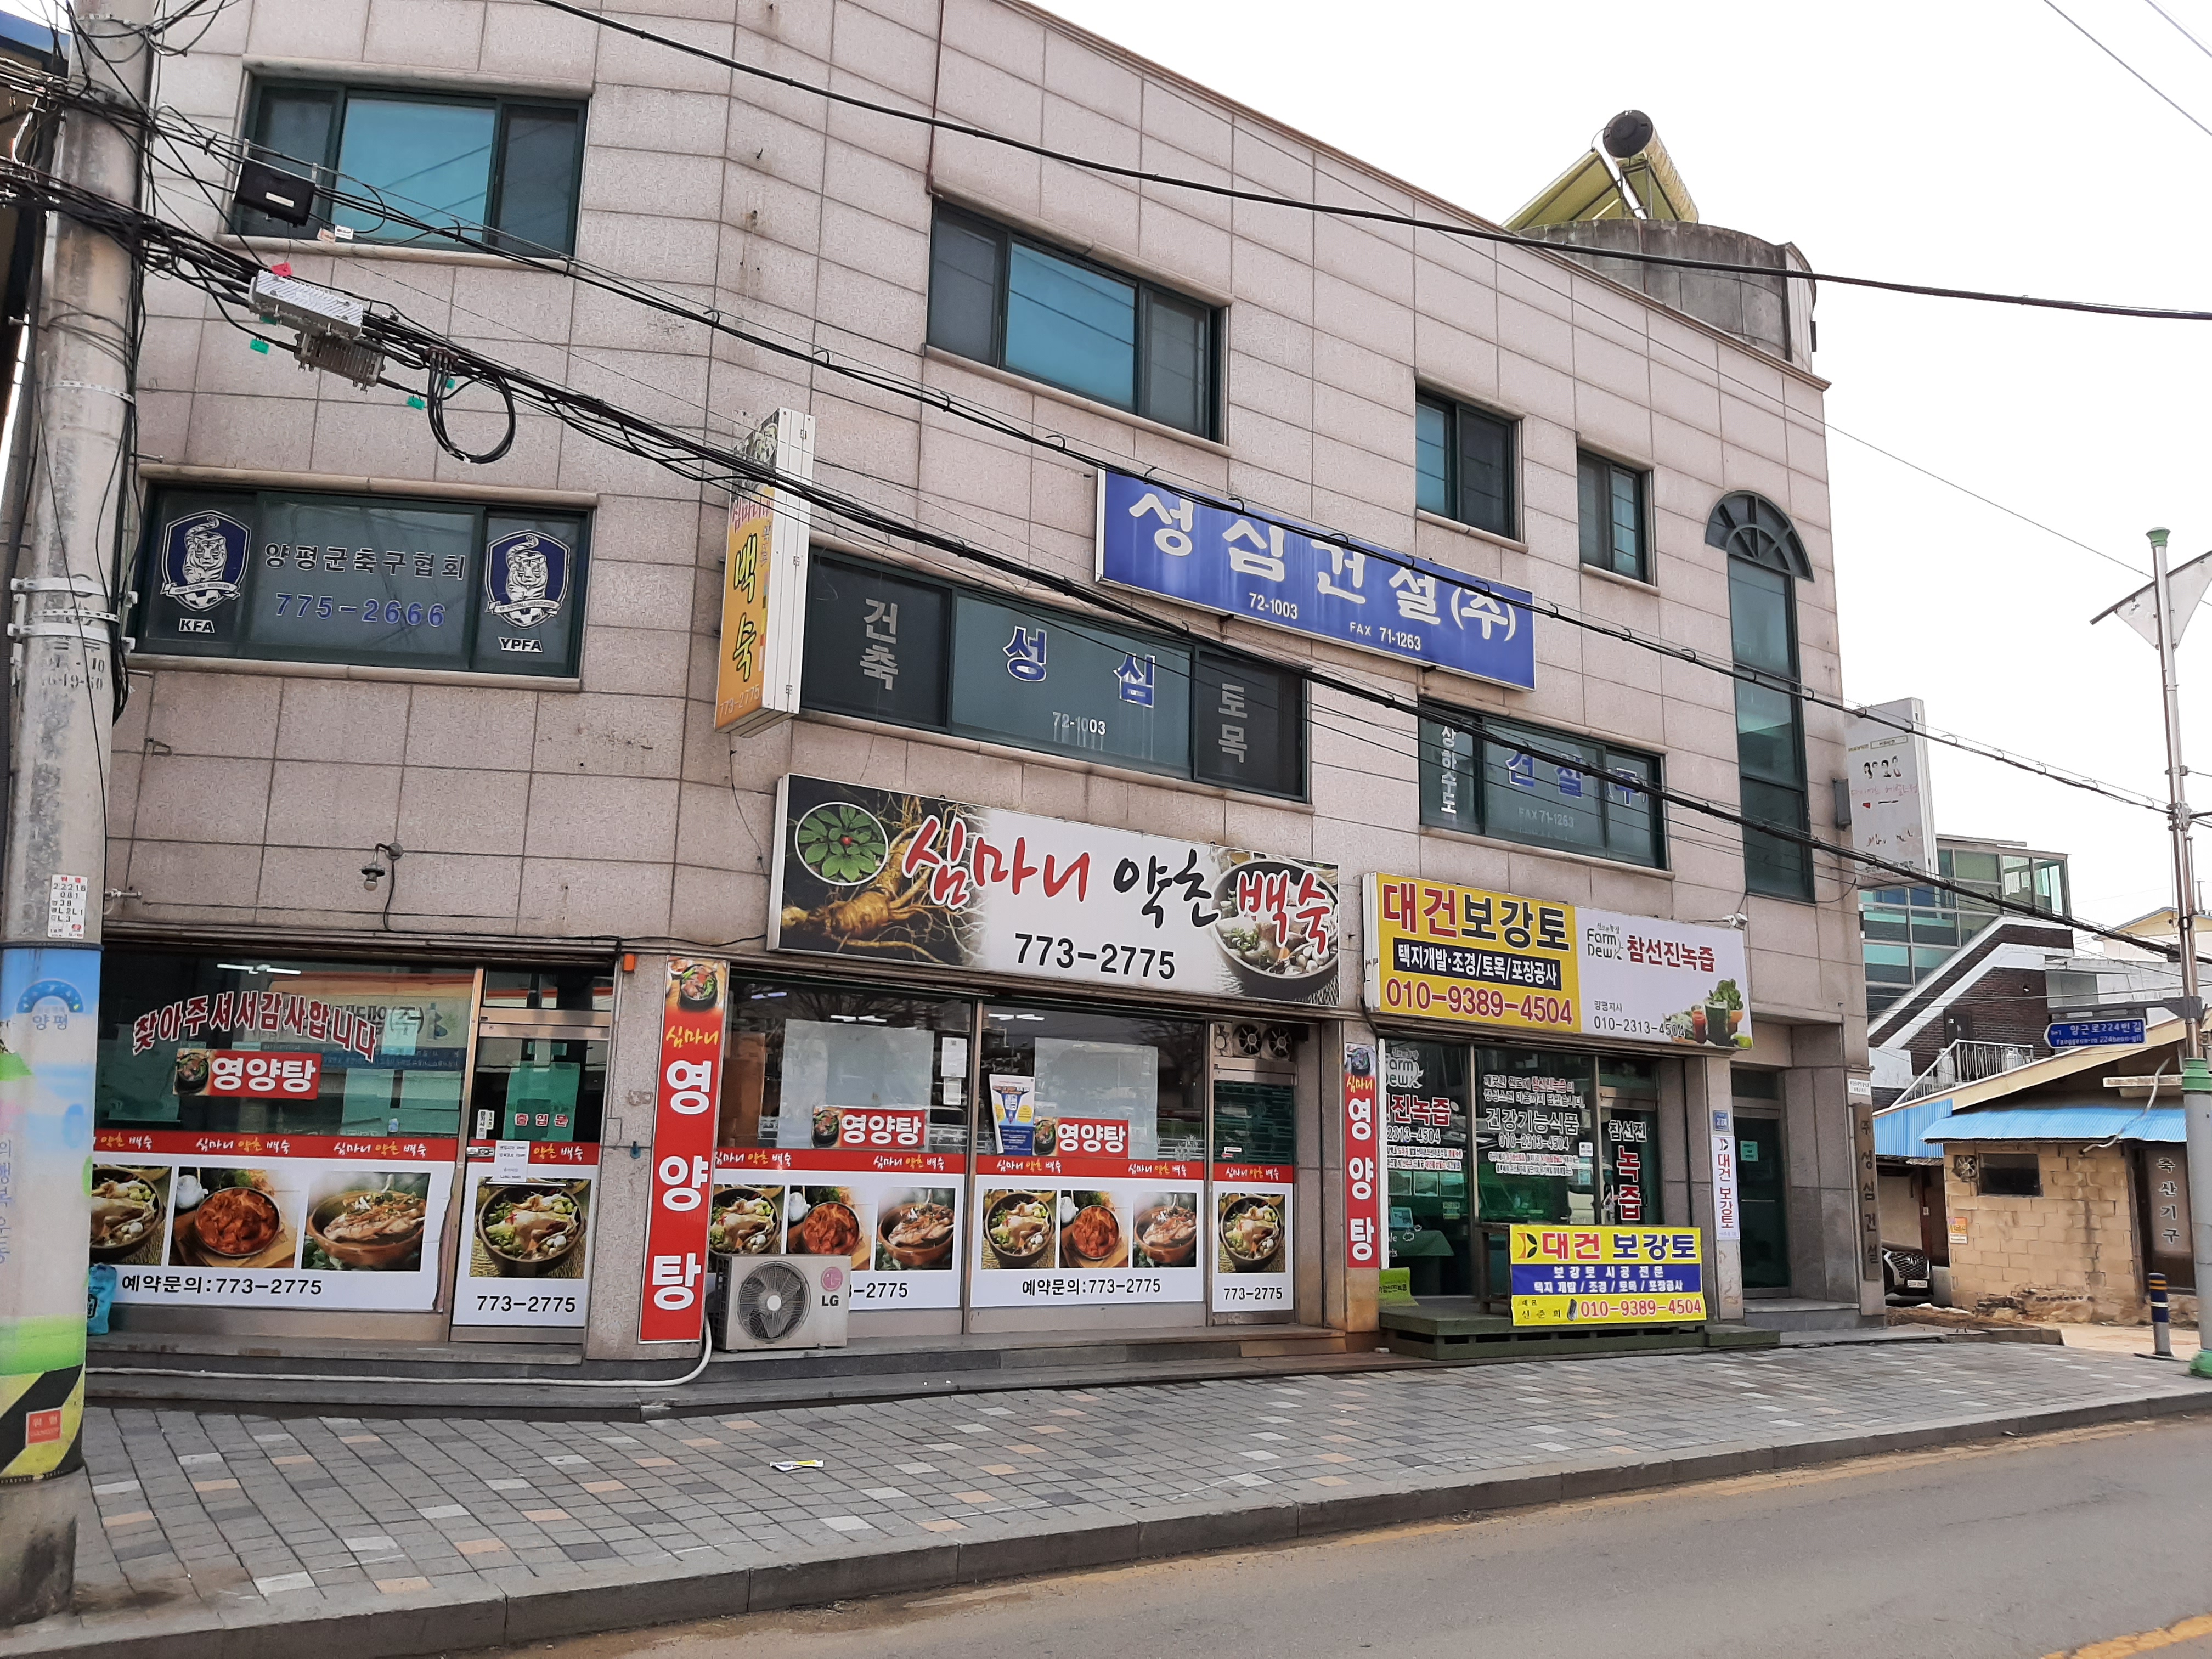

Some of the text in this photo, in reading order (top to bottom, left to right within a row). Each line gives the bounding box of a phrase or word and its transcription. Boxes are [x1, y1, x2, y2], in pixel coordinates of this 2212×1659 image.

[264, 542, 466, 581] 양평군축구협회
[275, 592, 445, 627] 775-2666
[733, 533, 758, 682] 백숙
[1249, 592, 1298, 620] 72-1003
[179, 619, 215, 633] KFA
[1350, 622, 1422, 651] FAX 71-1263
[500, 637, 543, 653] YPFA
[861, 598, 899, 691] 건축
[720, 684, 760, 719] 773-2775
[1053, 712, 1106, 736] 72-1003
[1218, 682, 1248, 763] 토목
[1441, 725, 1457, 815] 상하수도
[1518, 807, 1575, 827] FAX 71-1263
[901, 814, 1333, 955] 심마니 약초 백숙
[1383, 882, 1570, 952] 대건보강토
[1587, 928, 1616, 945] Farm
[1014, 933, 1176, 980] 773-2775
[1588, 943, 1613, 958] Dew
[1627, 934, 1715, 972] 참선진녹즙
[1386, 977, 1573, 1026] 010-9389-4504
[33, 1014, 67, 1030] 양평
[132, 990, 377, 1063] 찾아주셔서감사합니다
[1594, 1015, 1686, 1037] 010-2313-4504
[666, 1024, 719, 1049] 심마니
[212, 1056, 317, 1093] 영양탕
[1386, 1059, 1413, 1071] arm
[1347, 1075, 1374, 1093] 심마니
[1387, 1073, 1408, 1085] ew
[840, 1114, 922, 1146] 영양탕
[1485, 1108, 1580, 1135] 건강기능식품
[1607, 1119, 1647, 1143] 참선진
[101, 1133, 153, 1152] 약초 백숙
[196, 1137, 290, 1155] 심마니 약초 백숙
[334, 1141, 427, 1158] 심마니 약초 백숙
[1057, 1122, 1127, 1153] 영양탕
[1498, 1132, 1570, 1152] 010-2313-4504
[534, 1143, 557, 1160] 약초
[715, 1152, 792, 1167] 심마니 약초 백숙
[873, 1154, 945, 1171] 심마니 약초 백숙
[997, 1159, 1062, 1175] 심마니 약초 백숙
[1128, 1162, 1188, 1178] 심마니 약초 백숙
[1226, 1166, 1247, 1179] 심마니
[1265, 1167, 1280, 1181] 백숙
[1348, 1097, 1375, 1261] 영양탕
[1718, 1153, 1731, 1182] 대건
[652, 1060, 712, 1311] 영양탕
[1616, 1146, 1642, 1221] 녹즙
[1719, 1186, 1734, 1229] 보강토
[2157, 1156, 2180, 1244] 축산기구
[1542, 1232, 1697, 1261] 대건 보강토
[122, 1273, 323, 1295] 예약문의:773-2775
[849, 1282, 909, 1299] -2775
[1022, 1278, 1161, 1296] 예약문의:773-2775
[1223, 1287, 1283, 1301] 773-2775
[476, 1295, 577, 1313] 773-2775
[821, 1295, 839, 1307] LG
[1581, 1298, 1702, 1318] 010-9389-4504
